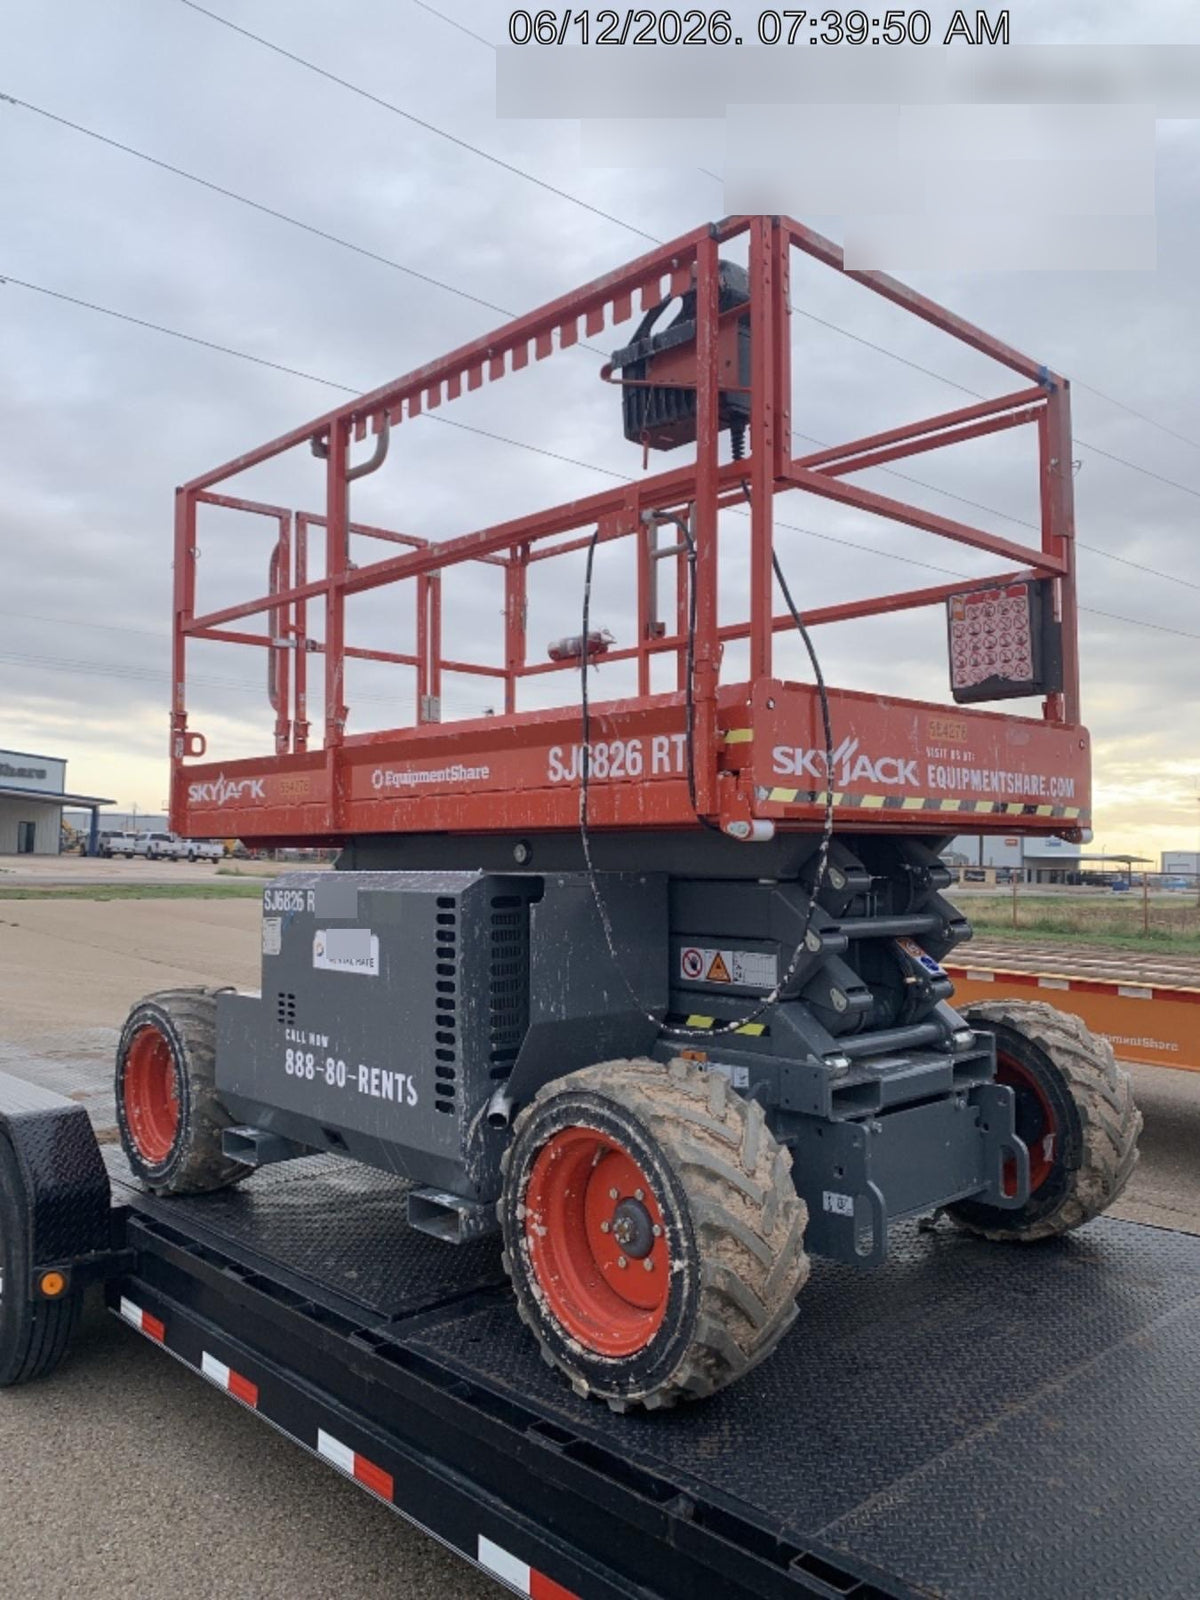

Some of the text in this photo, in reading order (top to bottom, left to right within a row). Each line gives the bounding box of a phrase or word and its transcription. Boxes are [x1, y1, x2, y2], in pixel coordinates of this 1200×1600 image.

[548, 733, 688, 782] SJ6826 RT
[772, 735, 920, 787] SKYJACK
[926, 746, 947, 760] VISIT
[385, 764, 490, 788] EquipmentShare
[927, 763, 1075, 798] EQUIPMENTSHARE.COM
[264, 889, 304, 912] SJ6826
[285, 1028, 329, 1048] CALL NOW
[285, 1048, 418, 1107] 888-80-RENTS
